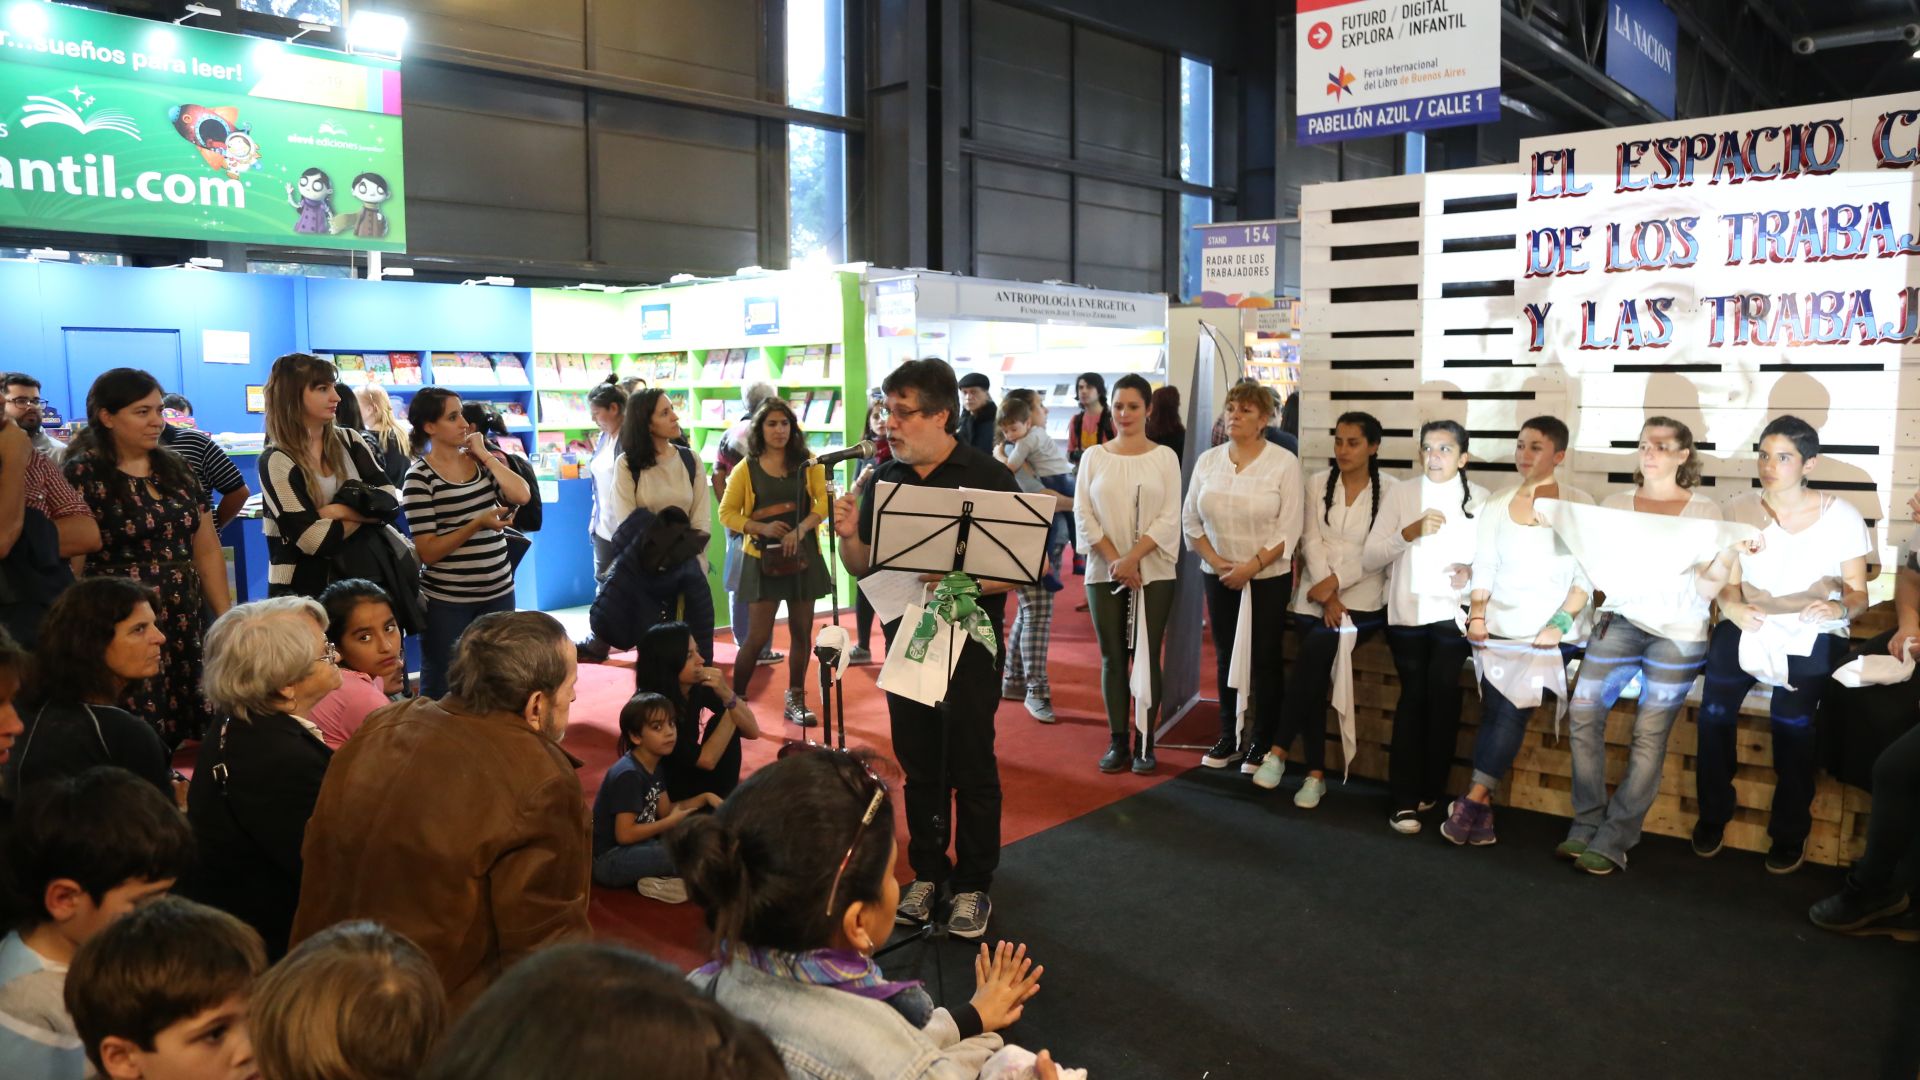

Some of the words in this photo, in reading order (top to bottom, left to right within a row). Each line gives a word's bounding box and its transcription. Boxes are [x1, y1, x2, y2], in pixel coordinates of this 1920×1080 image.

[1342, 9, 1387, 31] FUTURO
[1402, 0, 1449, 19] DIGITAL
[1342, 26, 1394, 49] EXPLORA
[1409, 13, 1467, 36] INFANTIL
[1615, 4, 1631, 41] LA
[132, 51, 187, 73] para
[192, 57, 242, 82] leer!
[1364, 68, 1384, 79] Feria
[1386, 57, 1438, 75] Internacional
[1364, 80, 1376, 91] del
[1378, 79, 1398, 89] Libro
[1400, 74, 1409, 85] de
[1411, 71, 1441, 84] Buenos
[1444, 67, 1467, 79] Aires
[1308, 107, 1373, 136] PABELLÓN
[1376, 105, 1411, 126] AZUL
[1415, 101, 1424, 120] /
[1428, 95, 1471, 118] CALLE
[1475, 93, 1483, 111] 1
[1528, 148, 1593, 201] EL
[1614, 117, 1844, 193] ESPACIO
[1872, 109, 1920, 169] C
[1208, 235, 1227, 246] STAND
[1244, 226, 1270, 243] 154
[1524, 225, 1592, 279] DE
[1604, 216, 1701, 274] LOS
[1206, 255, 1233, 266] RADAR
[1236, 254, 1247, 265] DE
[1249, 253, 1265, 264] LOS
[1206, 266, 1269, 278] TRABAJADORES
[1523, 302, 1553, 352] Y
[1579, 297, 1675, 351] LAS
